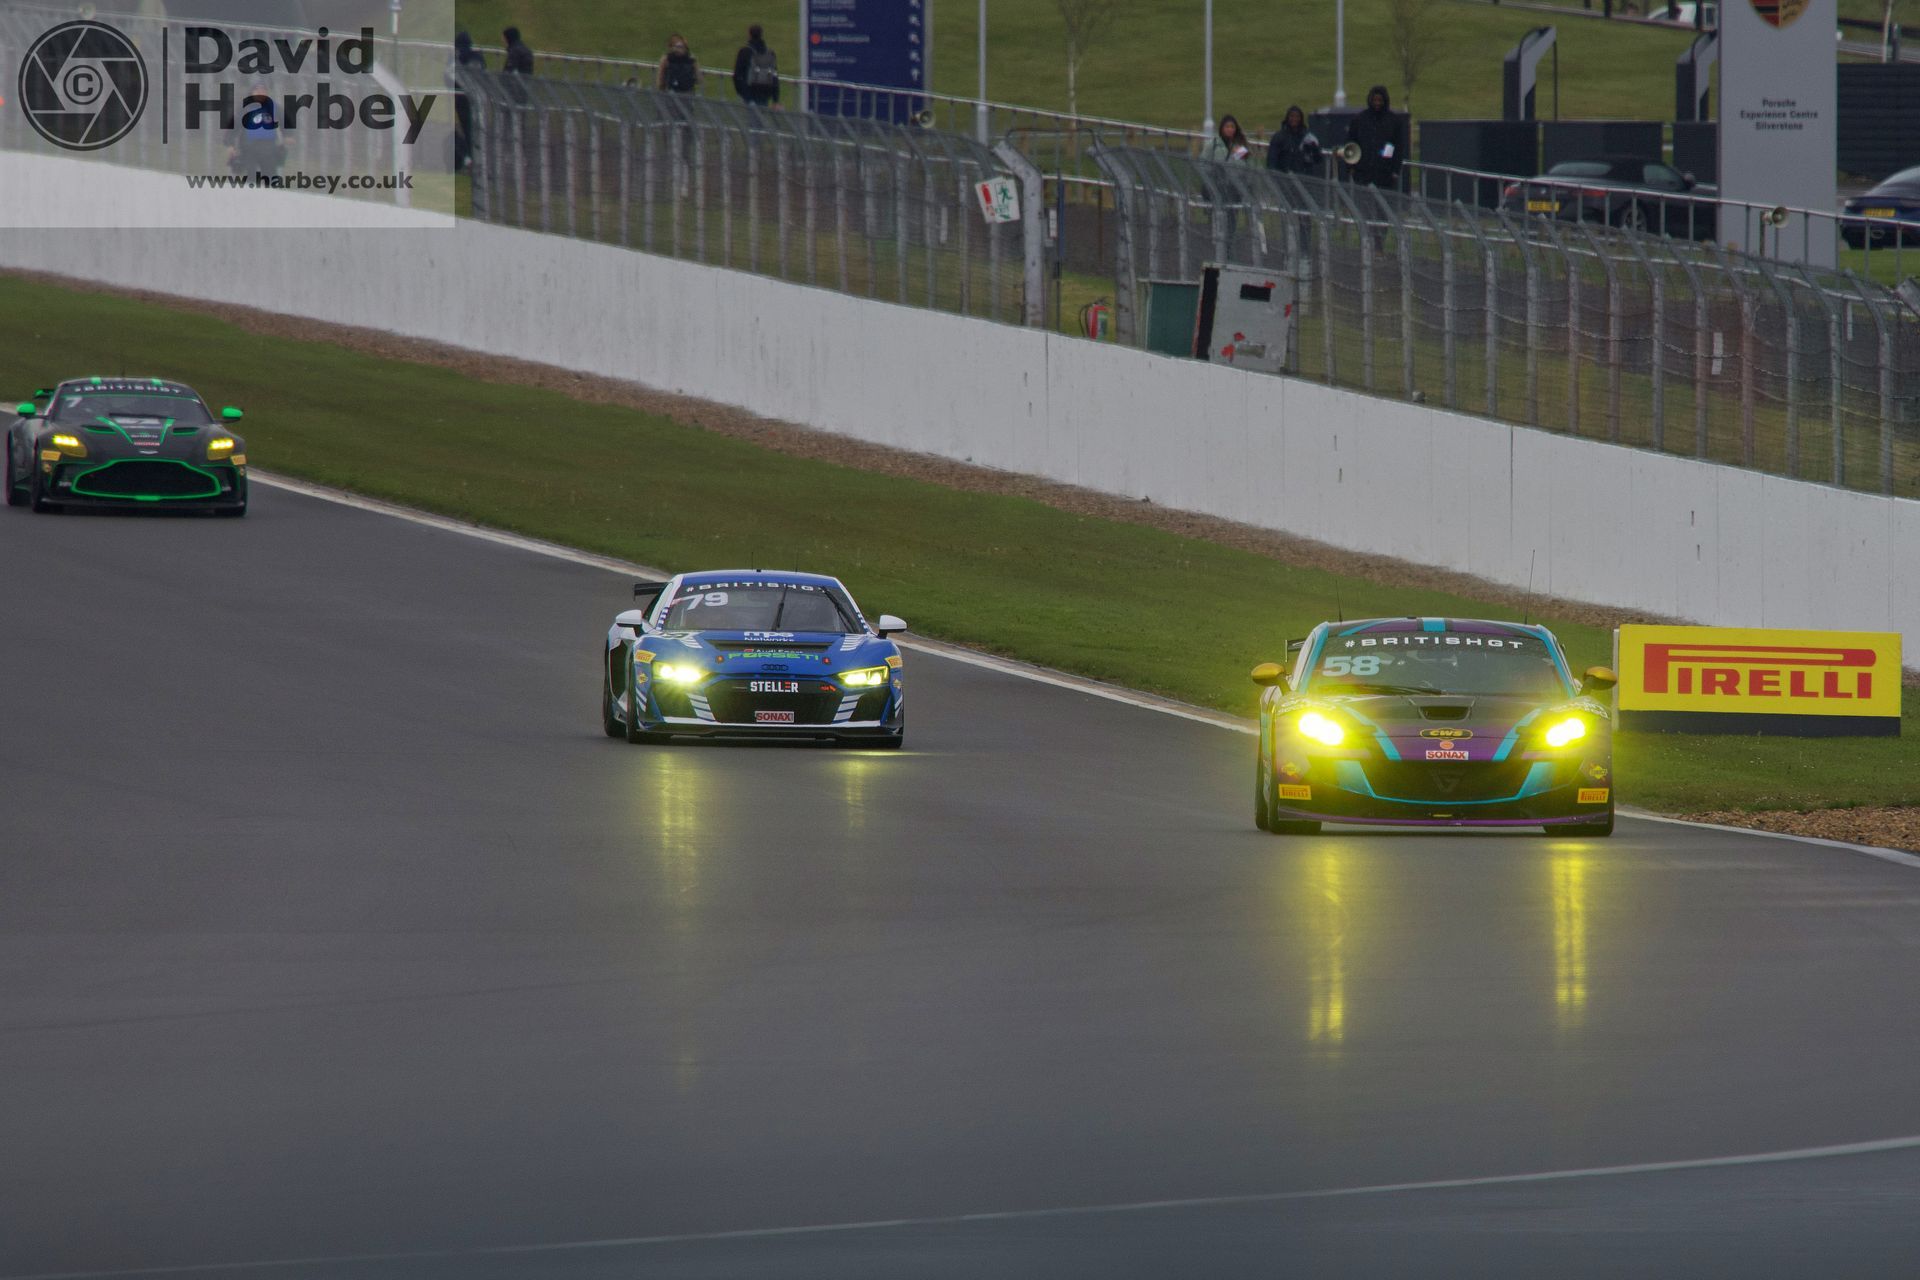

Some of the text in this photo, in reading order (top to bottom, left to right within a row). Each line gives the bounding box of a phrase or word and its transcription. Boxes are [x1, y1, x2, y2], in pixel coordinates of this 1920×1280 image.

[1762, 99, 1797, 108] Porsche
[1740, 110, 1787, 120] Experience
[680, 592, 729, 611] 79
[1345, 637, 1523, 649] #BRITISHGT
[1322, 655, 1380, 677] 58
[1643, 643, 1877, 699] PIRELLI
[750, 681, 799, 693] STELLER
[756, 712, 791, 721] SONAX
[1427, 751, 1466, 759] SONAX
